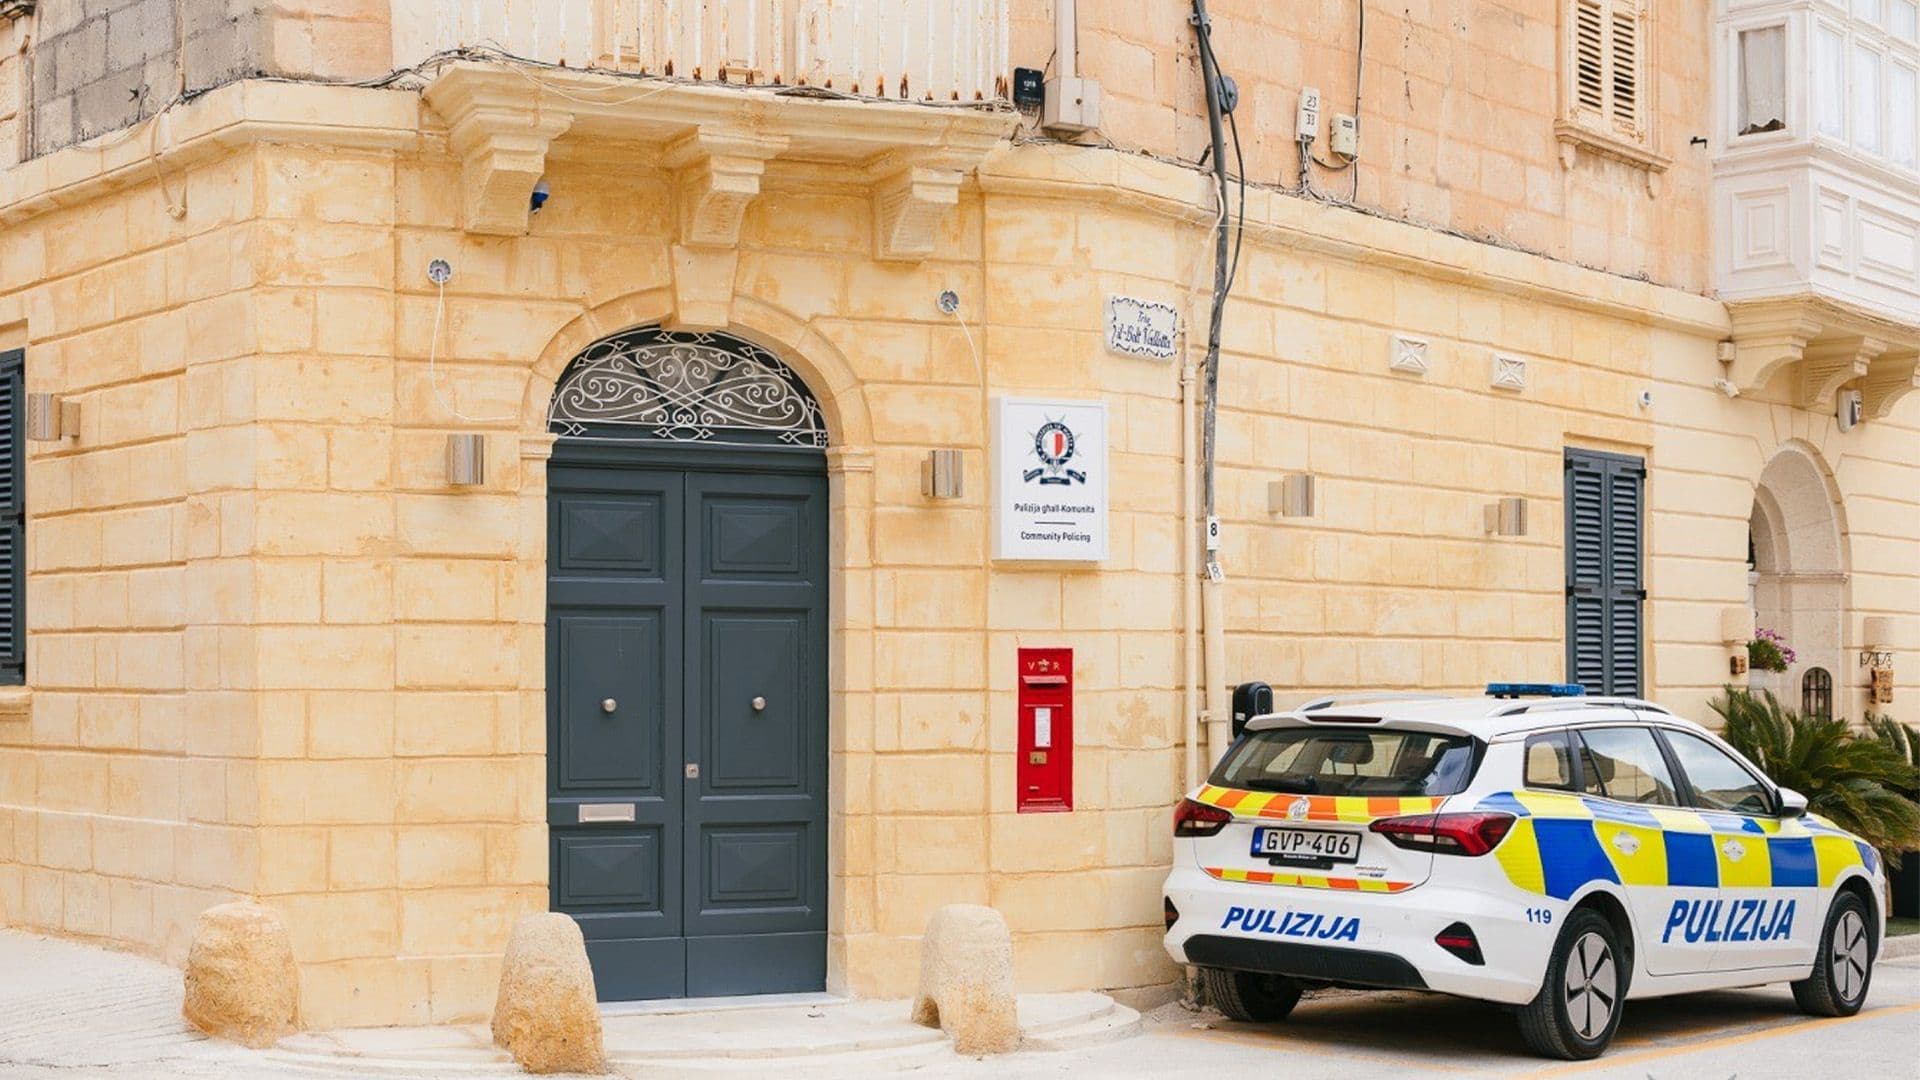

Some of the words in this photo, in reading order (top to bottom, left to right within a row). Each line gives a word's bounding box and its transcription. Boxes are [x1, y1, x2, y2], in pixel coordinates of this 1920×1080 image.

[1306, 95, 1317, 109] 23
[1021, 531, 1061, 543] Community
[1062, 531, 1091, 543] Policing
[1210, 522, 1218, 537] 8
[1027, 661, 1036, 670] V
[1053, 661, 1061, 671] R
[1526, 907, 1552, 925] 119
[1662, 899, 1796, 944] PULIZIJA
[1220, 906, 1361, 942] PULIZIJA
